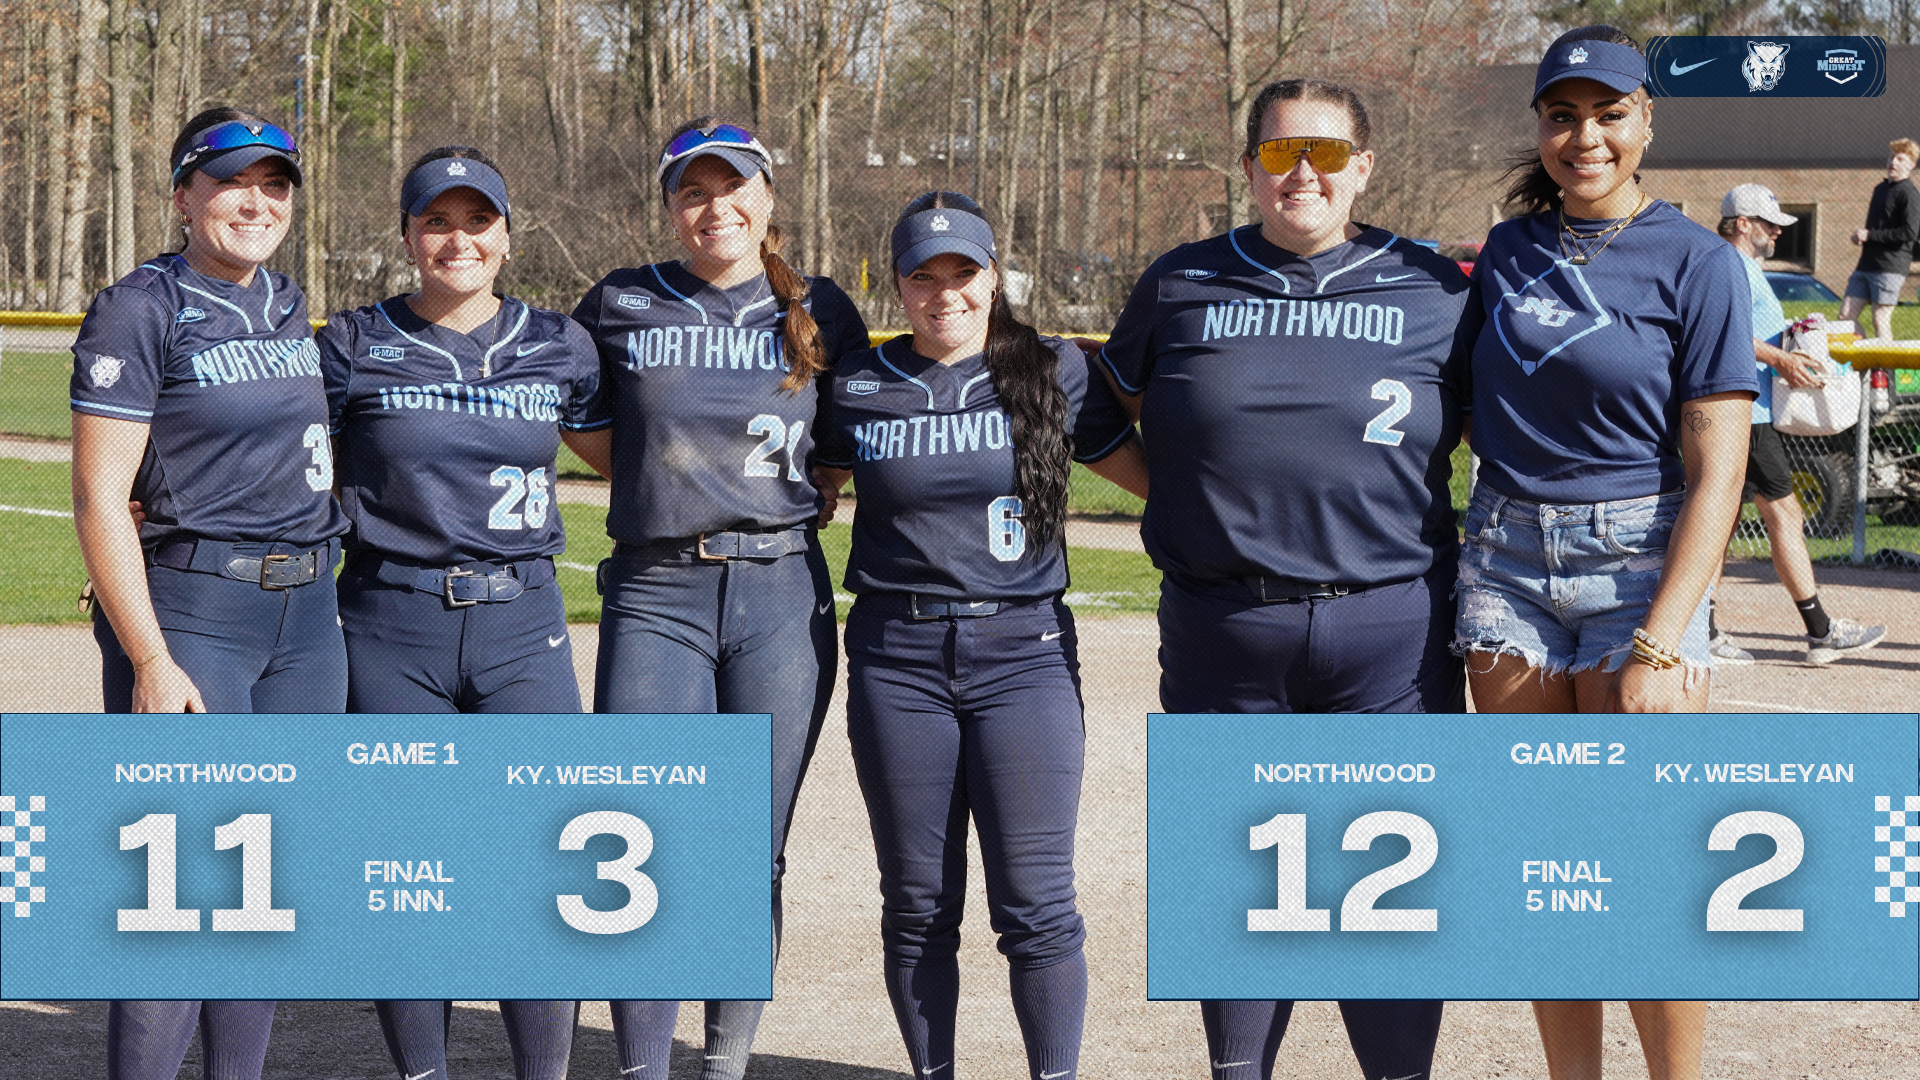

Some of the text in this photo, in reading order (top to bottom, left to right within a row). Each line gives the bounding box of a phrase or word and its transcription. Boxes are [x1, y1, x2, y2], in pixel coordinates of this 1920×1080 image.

[1202, 298, 1405, 346] NORTHWOOD
[1515, 296, 1576, 328] NU
[378, 382, 562, 422] NORTHWOOD
[1362, 378, 1412, 447] 2
[854, 410, 1016, 462] NORTHWO
[487, 465, 550, 531] 26
[987, 495, 1026, 562] 6
